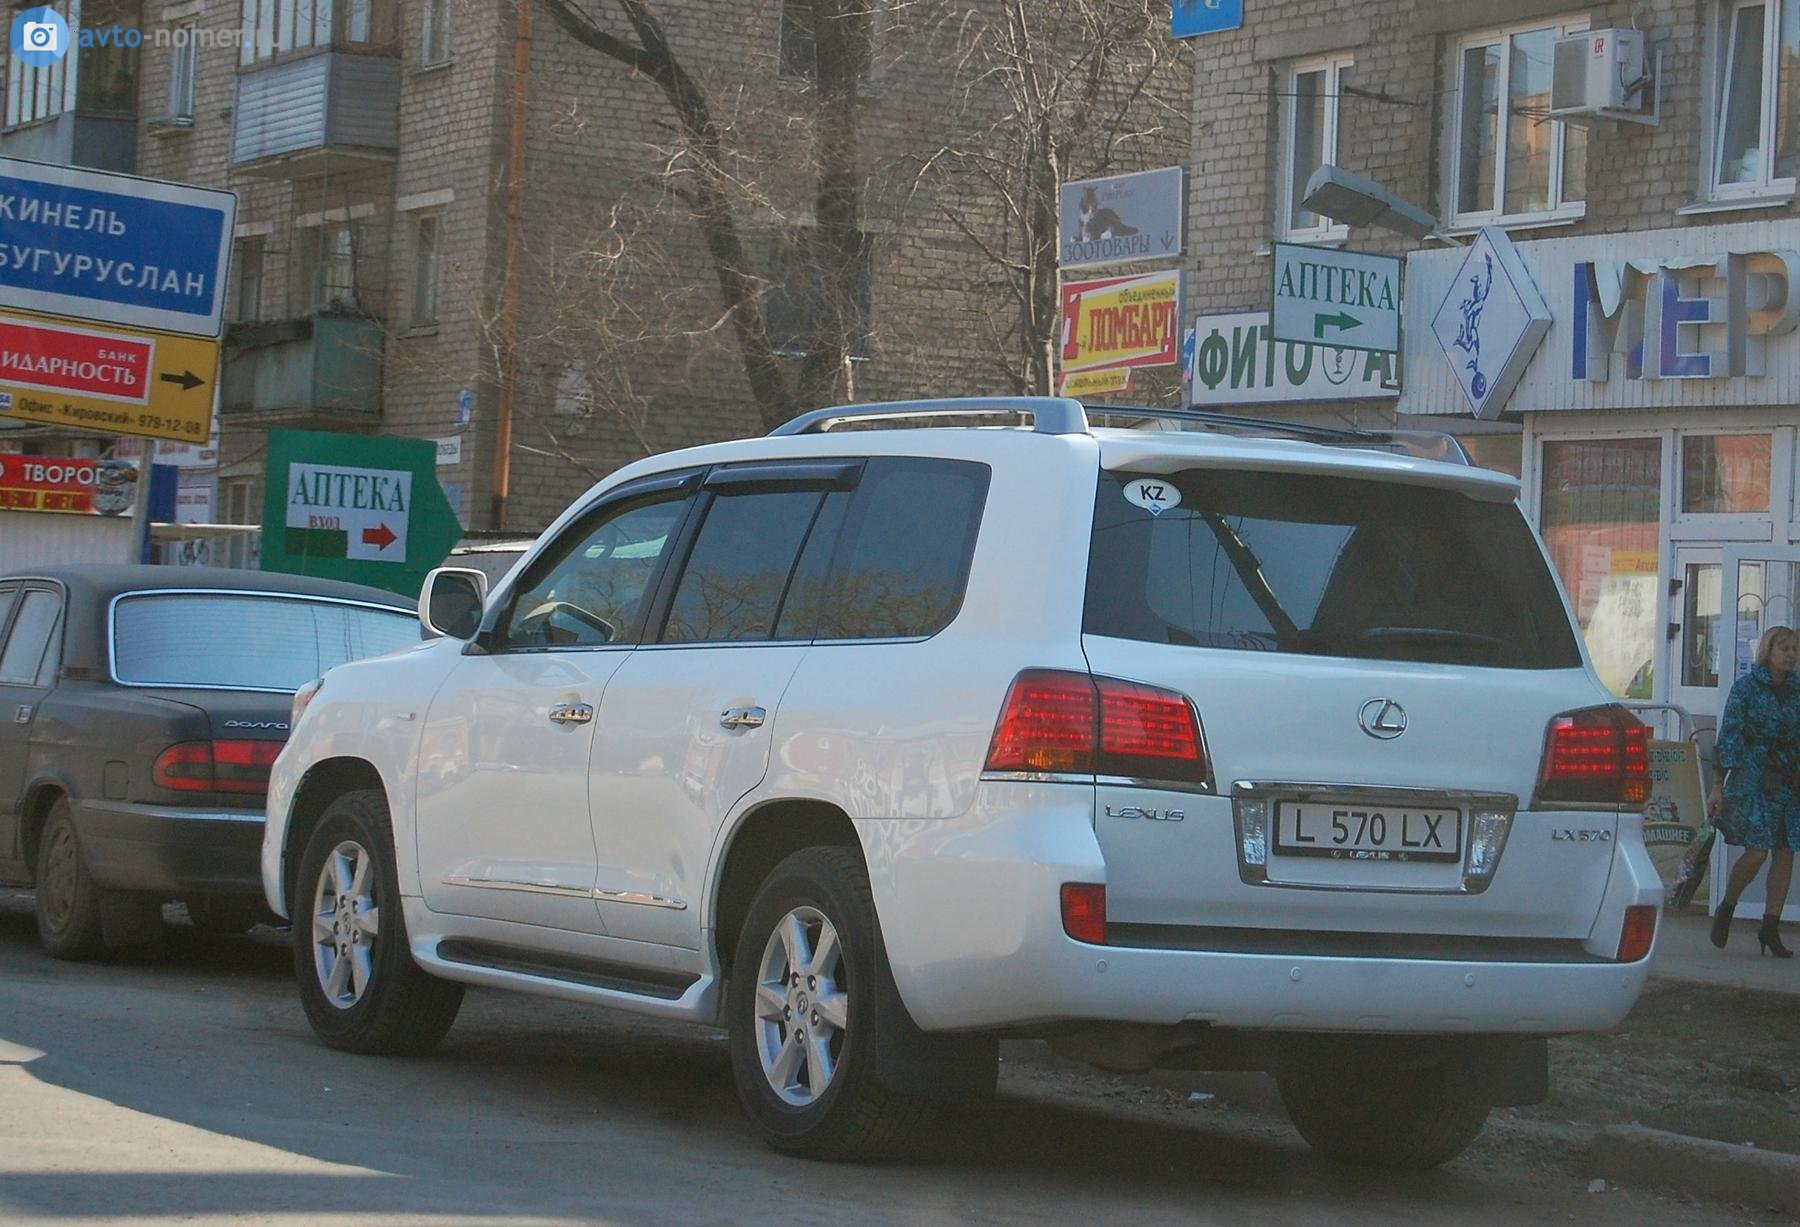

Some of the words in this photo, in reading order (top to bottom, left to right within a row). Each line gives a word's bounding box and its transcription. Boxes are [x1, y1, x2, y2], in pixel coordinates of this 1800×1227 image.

[0, 194, 126, 236] КИНЕЛЬ
[1063, 235, 1150, 263] ЗООТОВАРЫ
[1277, 261, 1395, 310] АПТЕКА
[1089, 300, 1177, 353] ЛОМБАРД
[2, 350, 136, 385] ИДАРНОСТЬ
[97, 349, 136, 363] БАНК
[1200, 325, 1314, 390] ФИТО
[23, 463, 104, 485] ТВОРОГ
[291, 469, 405, 512] АПТЕКА
[1140, 485, 1166, 501] KZ
[1105, 804, 1185, 821] LEXUS
[1295, 808, 1315, 842] L
[1332, 811, 1386, 846] 570
[1402, 814, 1443, 848] LX
[1552, 829, 1576, 841] LX
[1578, 829, 1611, 841] 570
